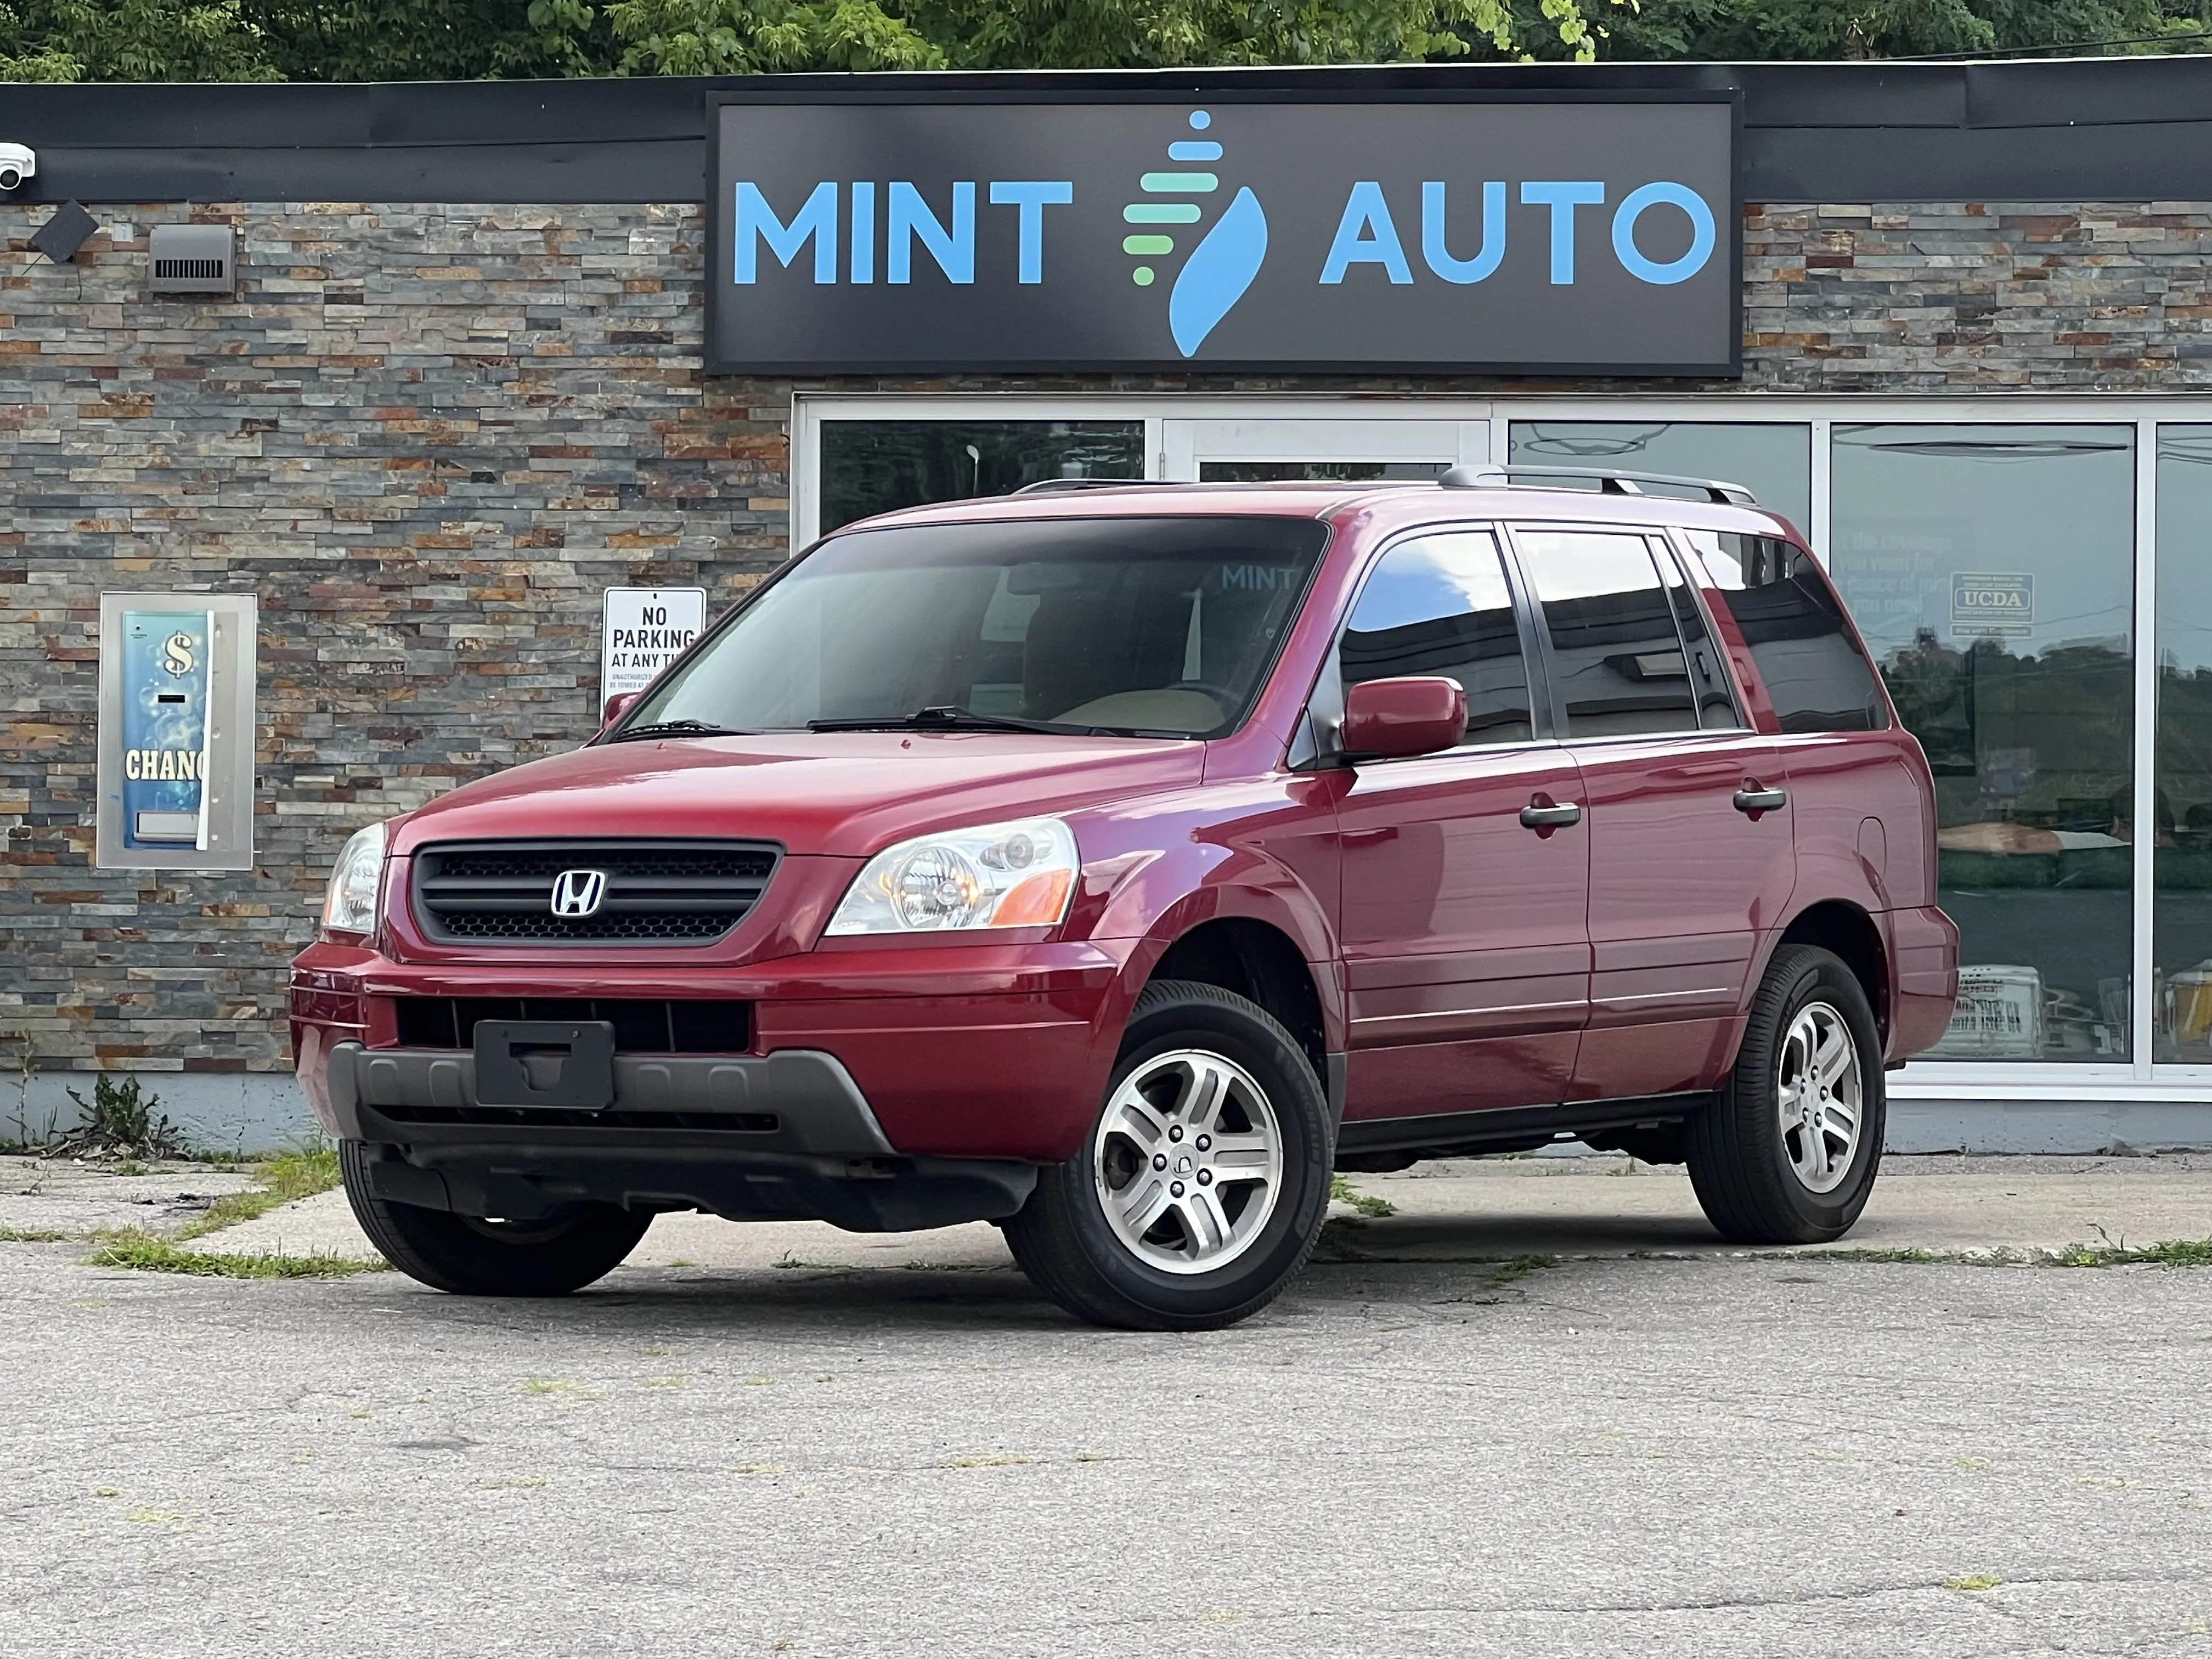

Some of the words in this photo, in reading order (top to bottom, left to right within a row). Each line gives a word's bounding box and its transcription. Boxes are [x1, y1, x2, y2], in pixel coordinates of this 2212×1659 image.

[734, 182, 1073, 284] MINT
[1318, 181, 1716, 285] AUTO
[1222, 565, 1300, 590] MINT
[1963, 591, 2022, 606] UCDA
[642, 607, 667, 626] NO
[613, 629, 695, 648] PARKING
[611, 653, 628, 668] AT
[631, 653, 659, 668] ANY
[125, 749, 204, 781] CHAN
